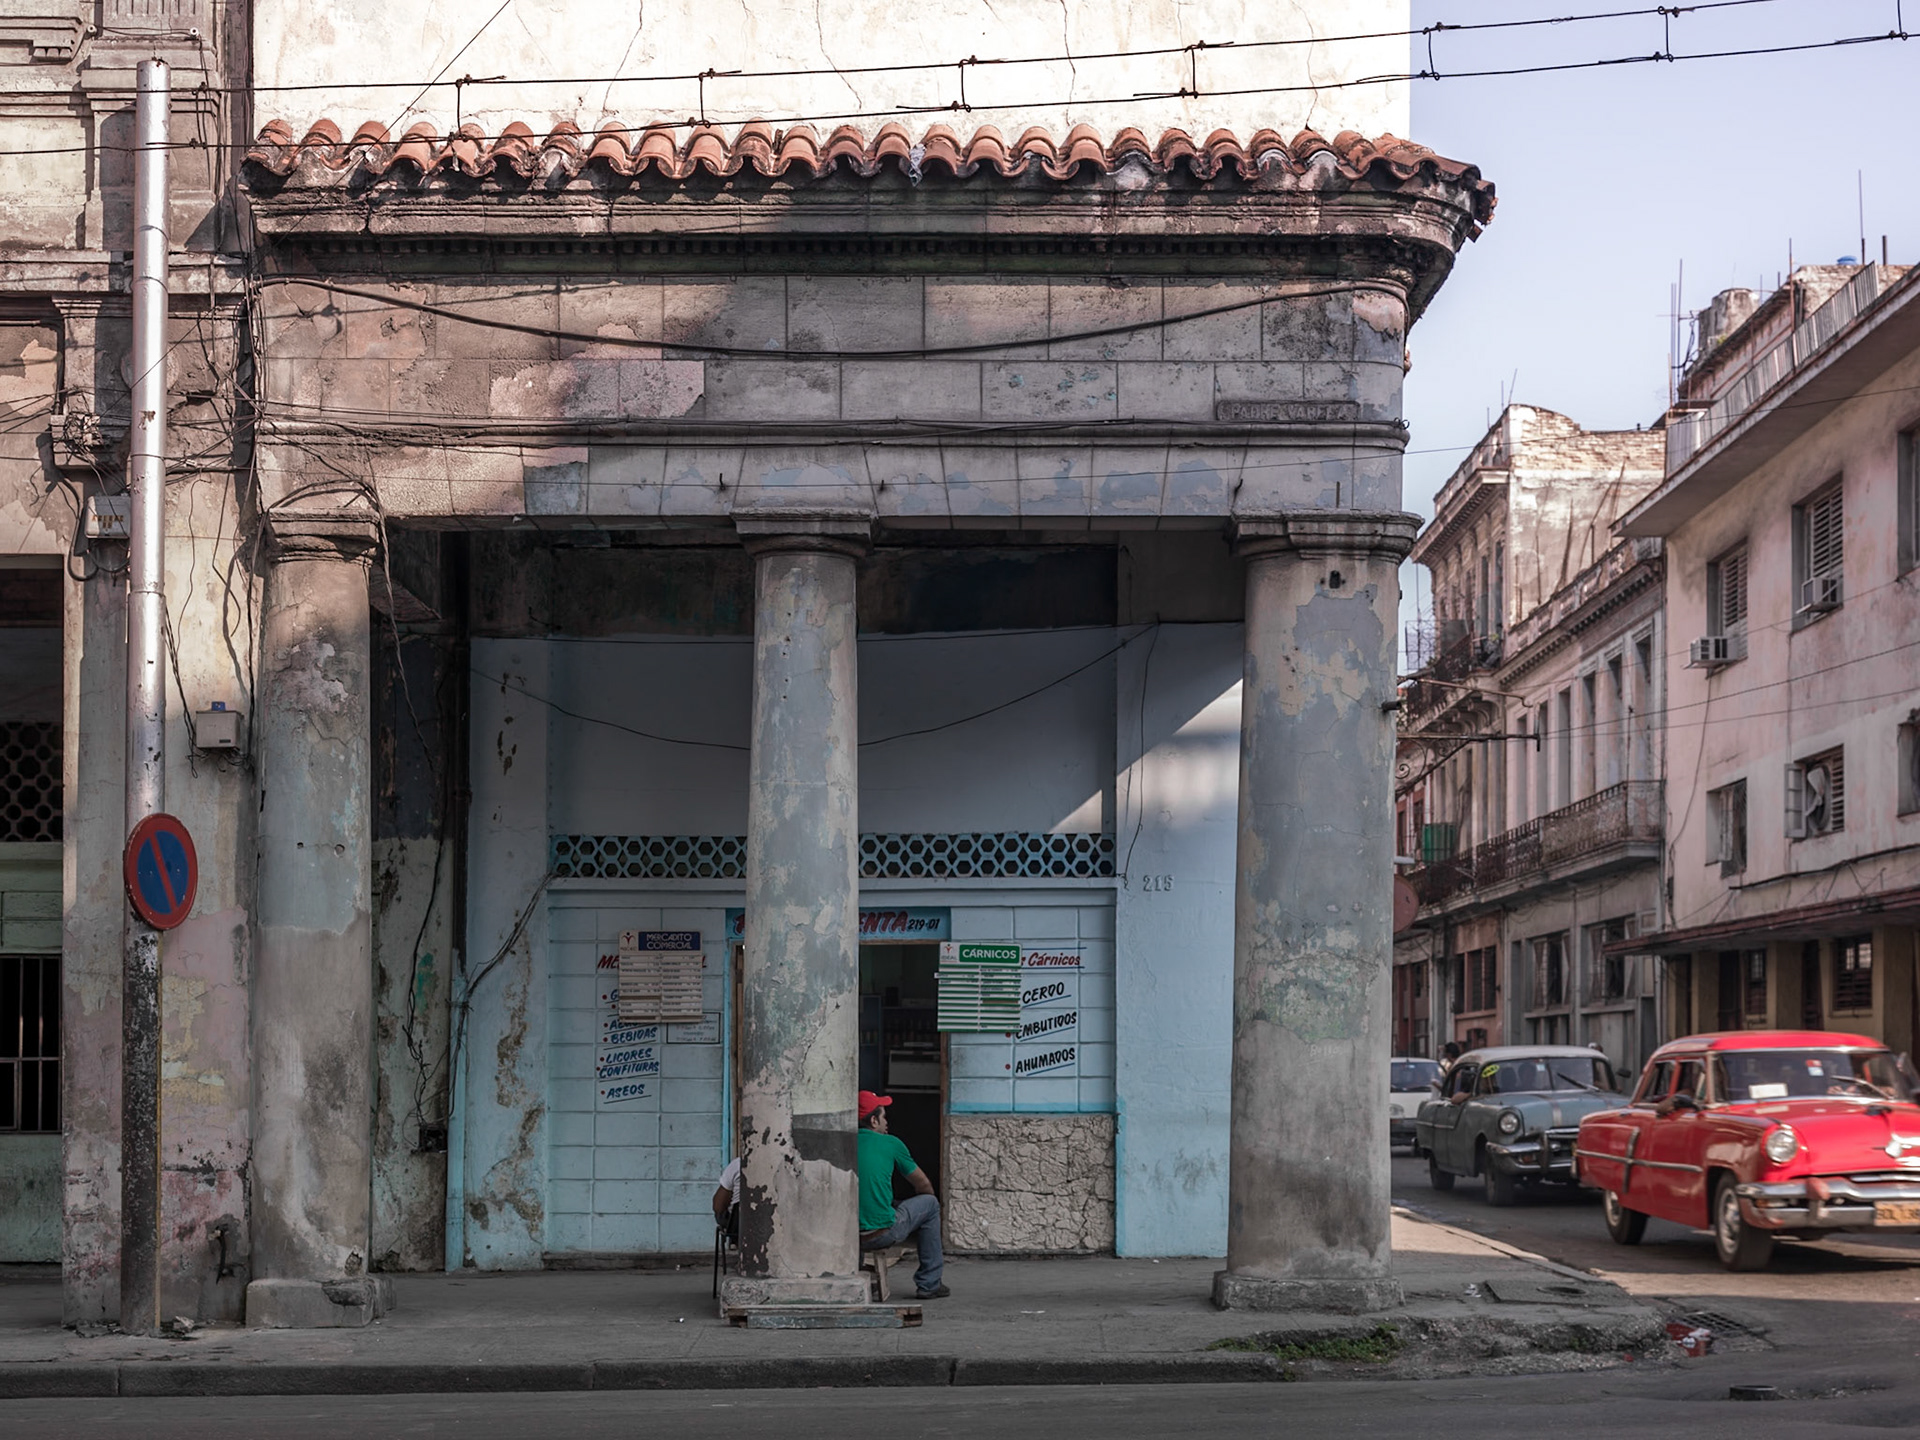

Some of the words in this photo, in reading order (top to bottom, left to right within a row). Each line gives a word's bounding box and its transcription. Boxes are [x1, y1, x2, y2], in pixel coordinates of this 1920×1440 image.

[646, 933, 692, 942] MERCADITO
[646, 942, 693, 950] COMERCIAL
[962, 948, 1017, 960] CÁRNICOS
[1028, 951, 1081, 966] Cárnicos
[1022, 981, 1065, 1004] CERDO
[1015, 1011, 1077, 1039] EMBUTIDOS
[610, 1027, 657, 1044] BEBIDAS
[605, 1047, 653, 1064] LICORES
[1015, 1047, 1075, 1073] AHUMADOS
[599, 1061, 659, 1079] CONFITURAS
[606, 1084, 645, 1099] ASEOS
